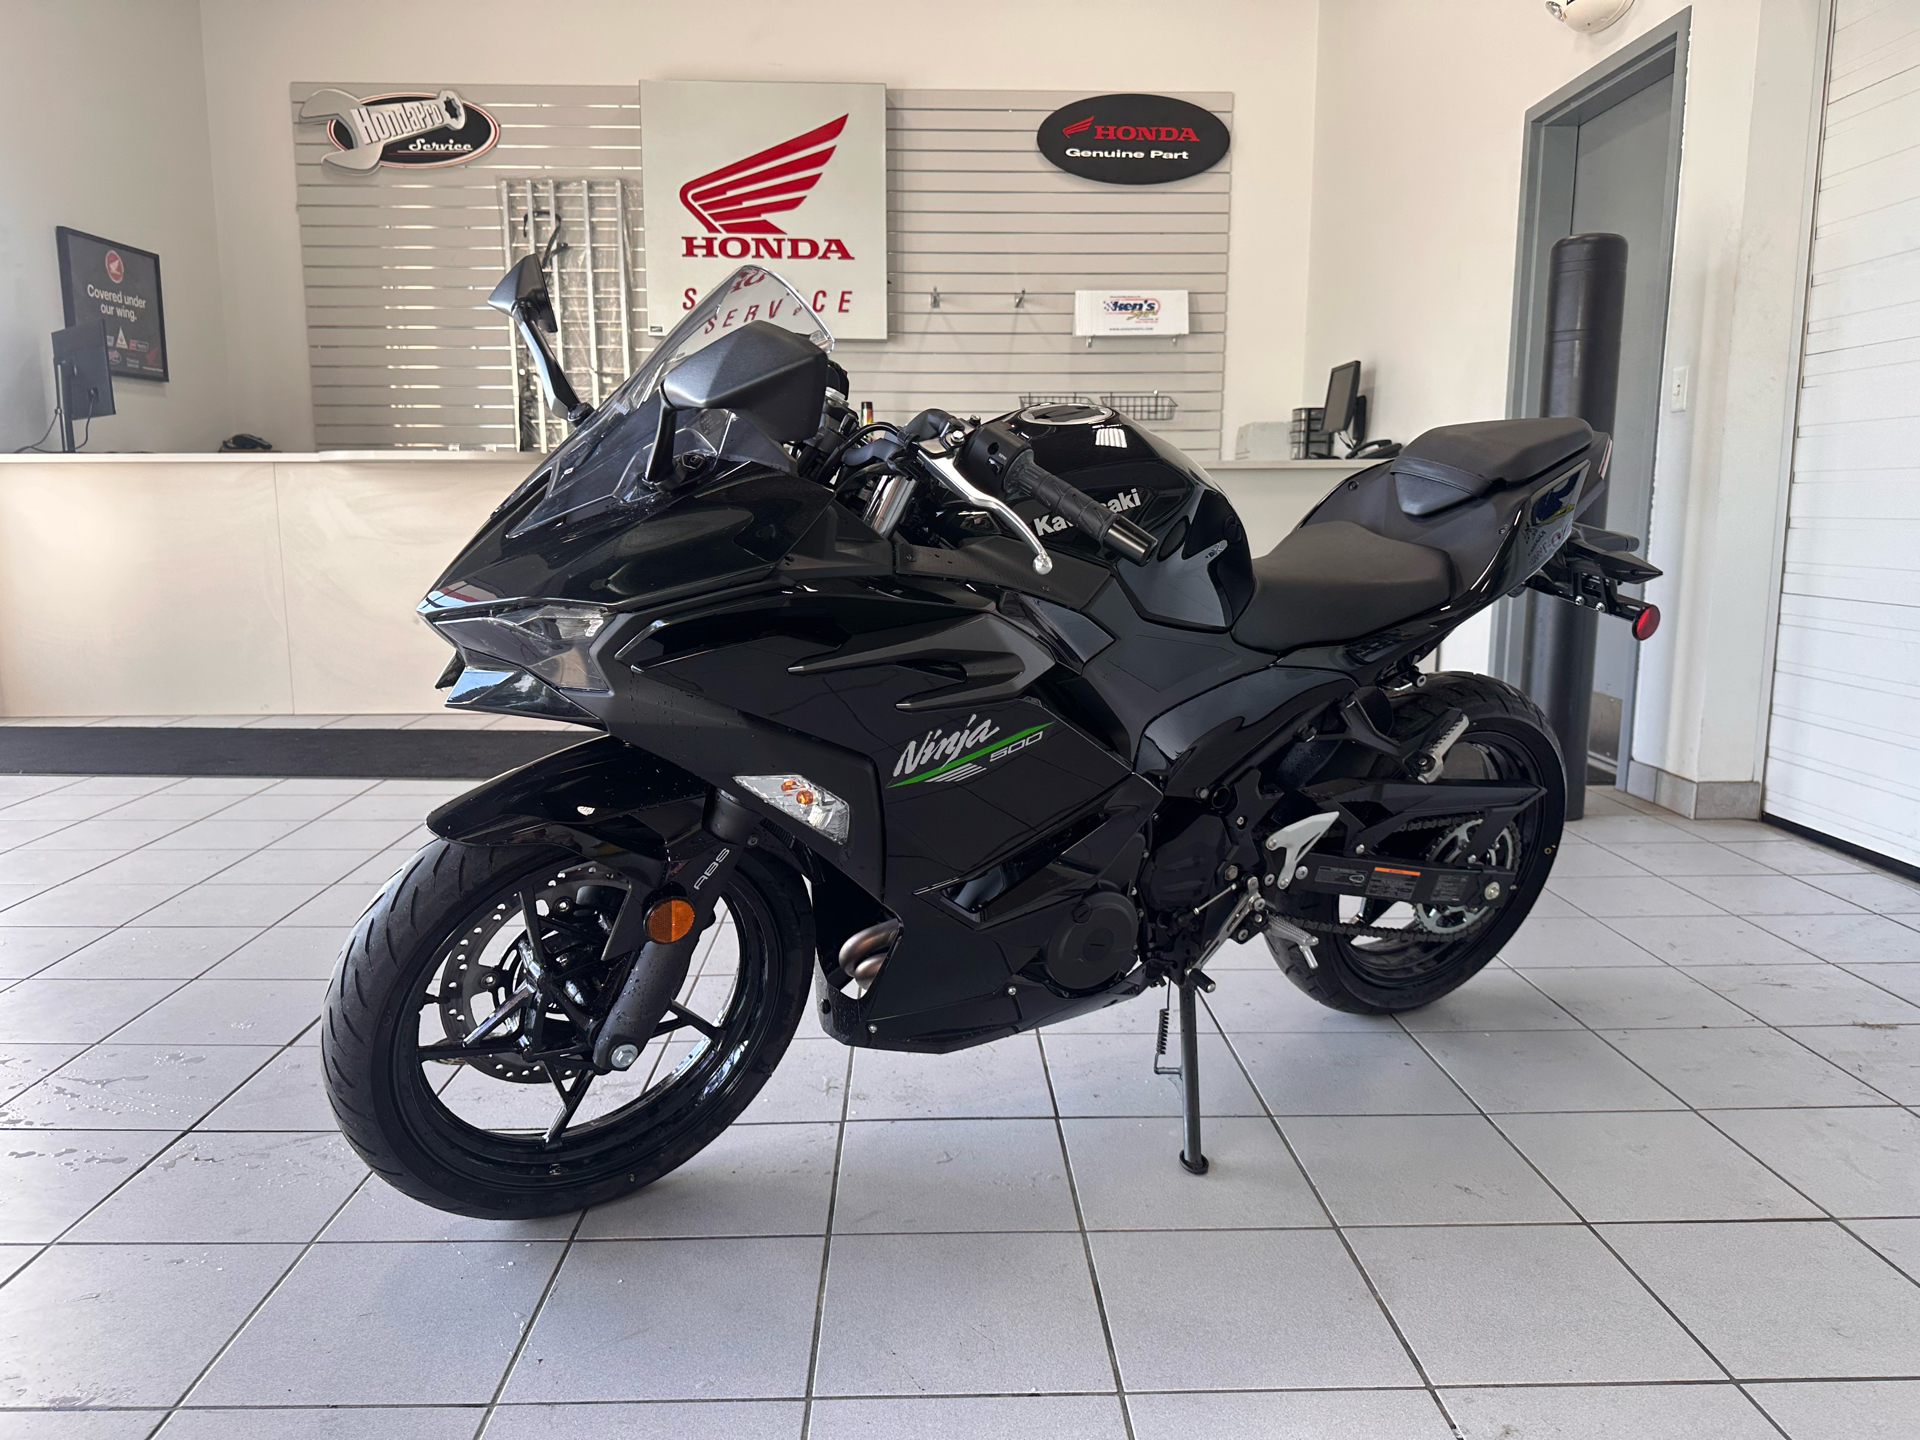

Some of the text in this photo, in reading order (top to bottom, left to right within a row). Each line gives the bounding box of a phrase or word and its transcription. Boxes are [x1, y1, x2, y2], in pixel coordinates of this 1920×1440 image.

[408, 138, 473, 151] Service
[1093, 125, 1200, 142] HONDA
[1065, 147, 1189, 160] Genuine Part
[681, 236, 855, 260] HONDA
[87, 284, 146, 309] Covered under
[100, 303, 138, 323] our wing.
[682, 287, 853, 334] SERVCE
[1034, 488, 1141, 536] Kaaki
[893, 714, 1000, 771] Ninja
[989, 730, 1044, 762] 500
[693, 848, 730, 890] ABS
